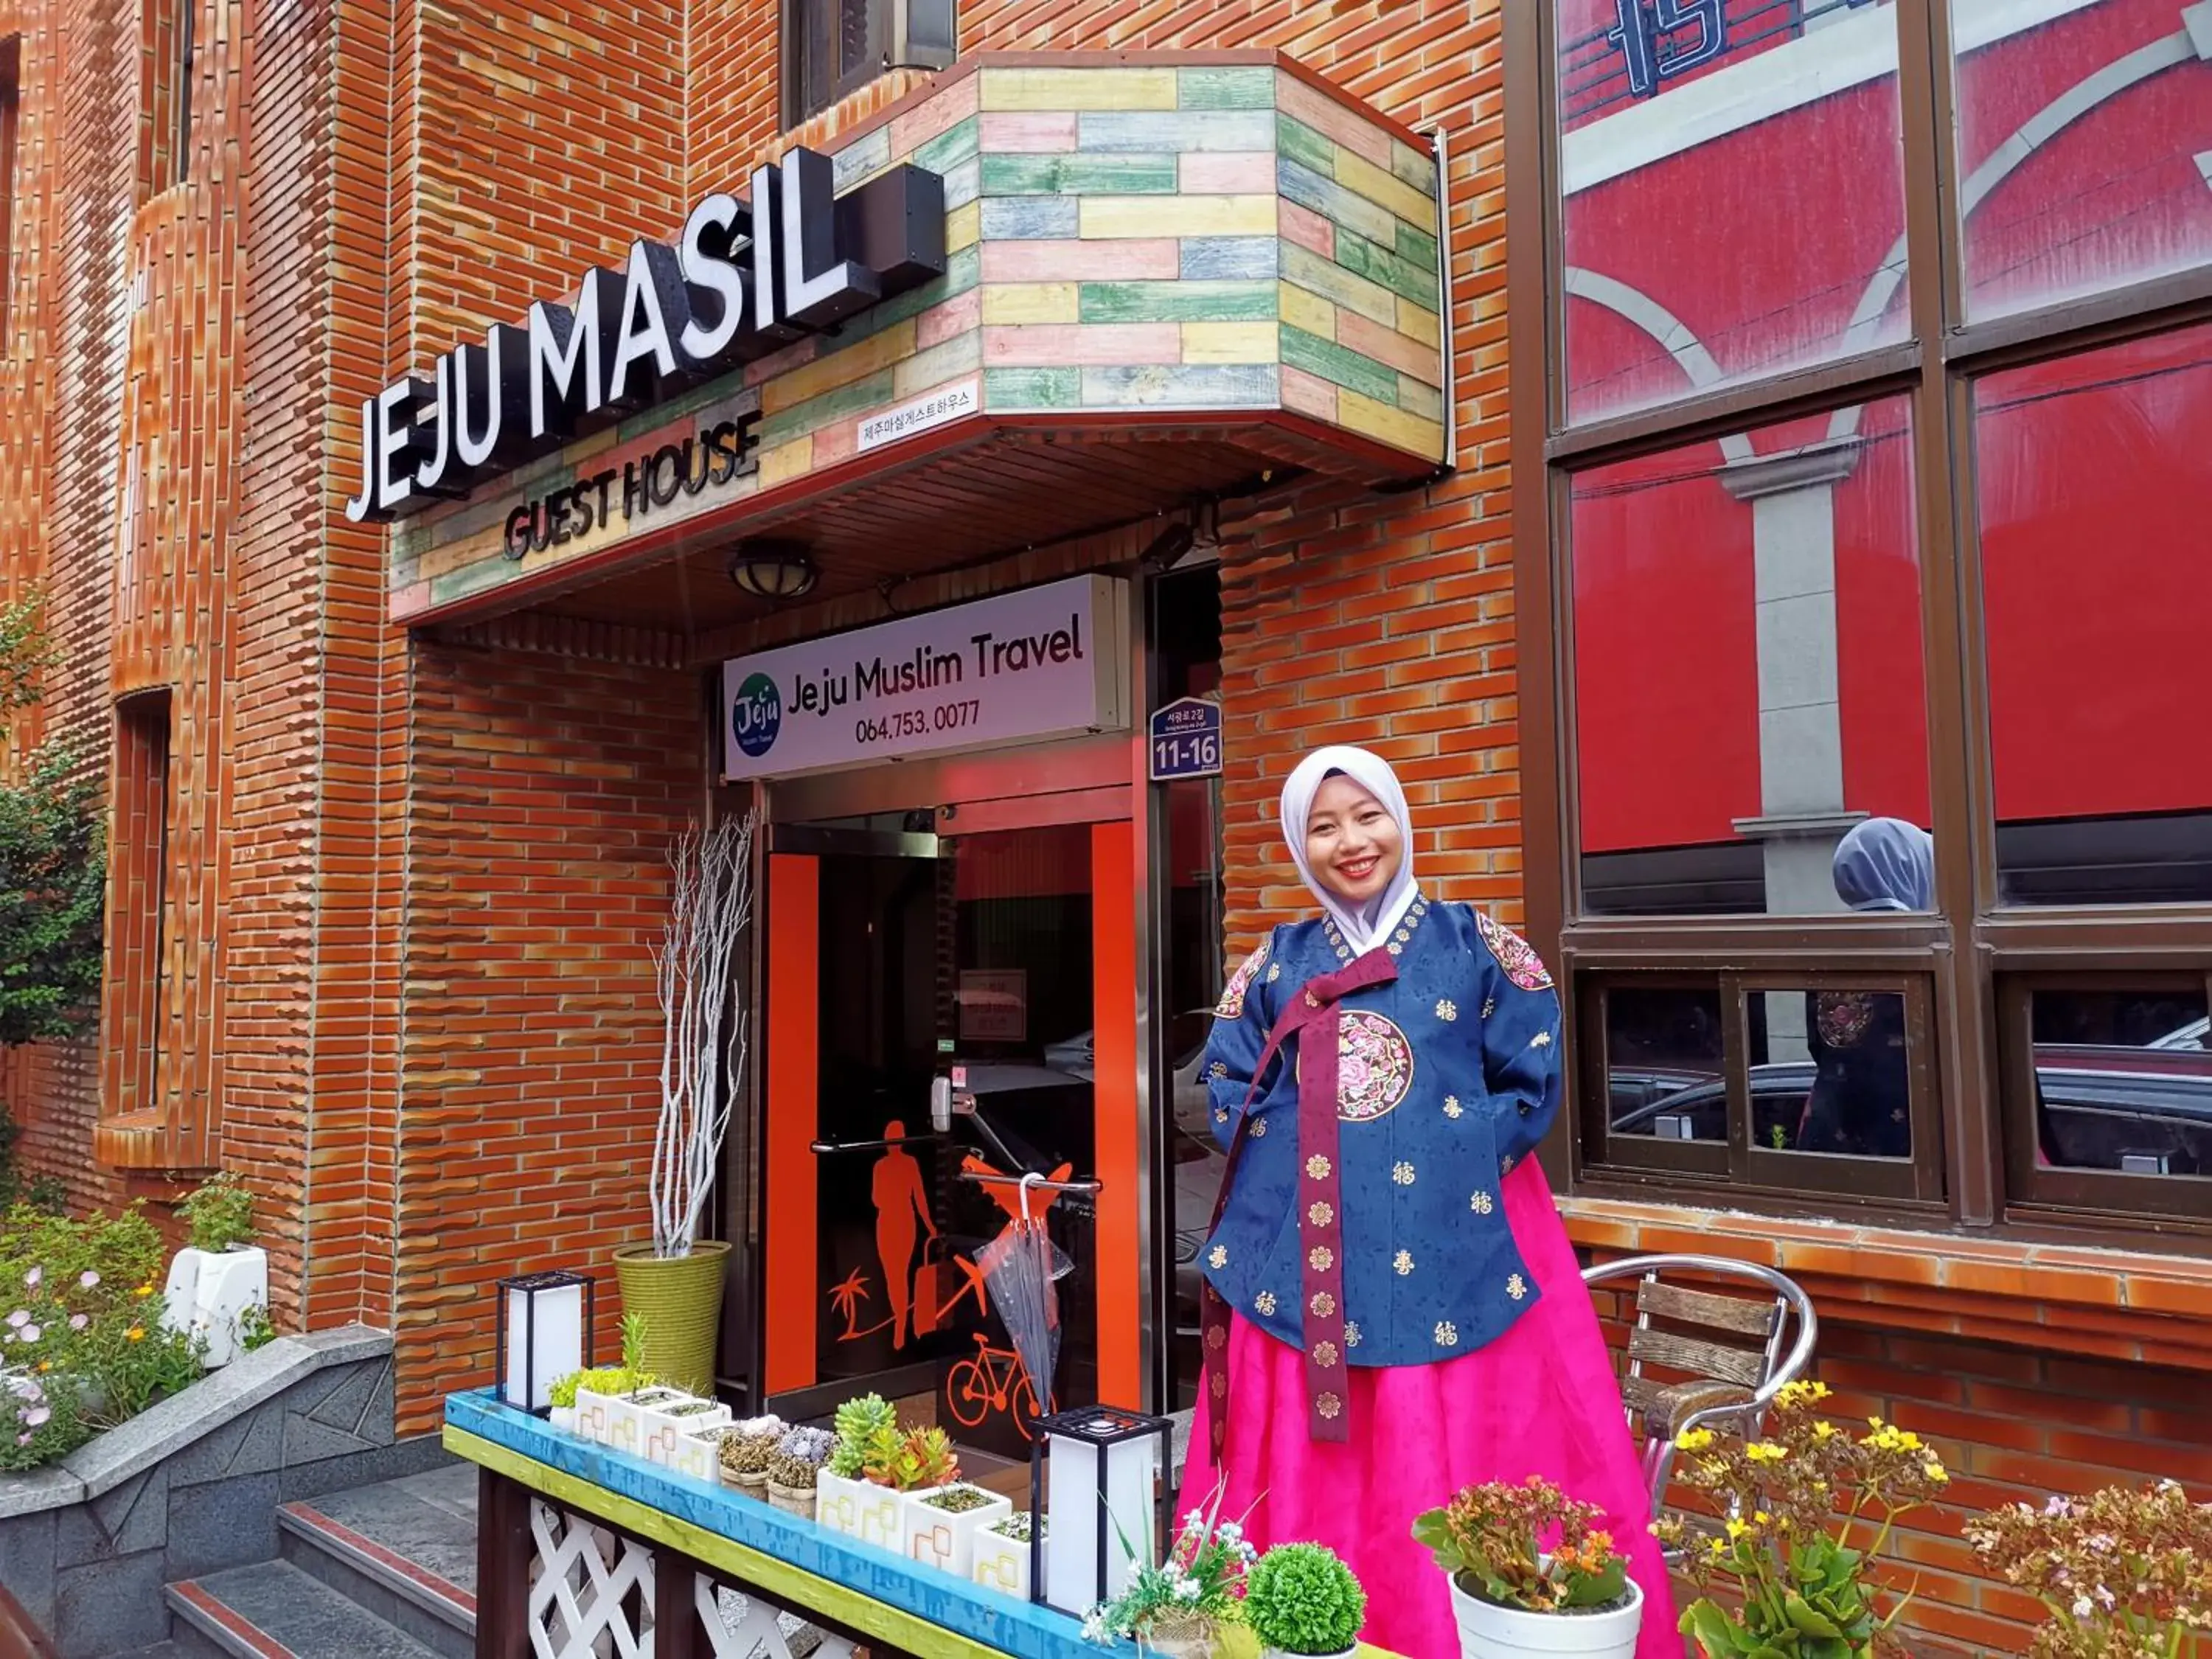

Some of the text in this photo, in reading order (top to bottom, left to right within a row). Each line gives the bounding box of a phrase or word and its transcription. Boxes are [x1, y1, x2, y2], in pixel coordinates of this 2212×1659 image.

[345, 145, 850, 523] JEJU MASIL
[504, 409, 764, 561] GUEST HOUSE
[788, 613, 1083, 717] Jeju Muslim Travel
[1155, 735, 1217, 770] 11-16
